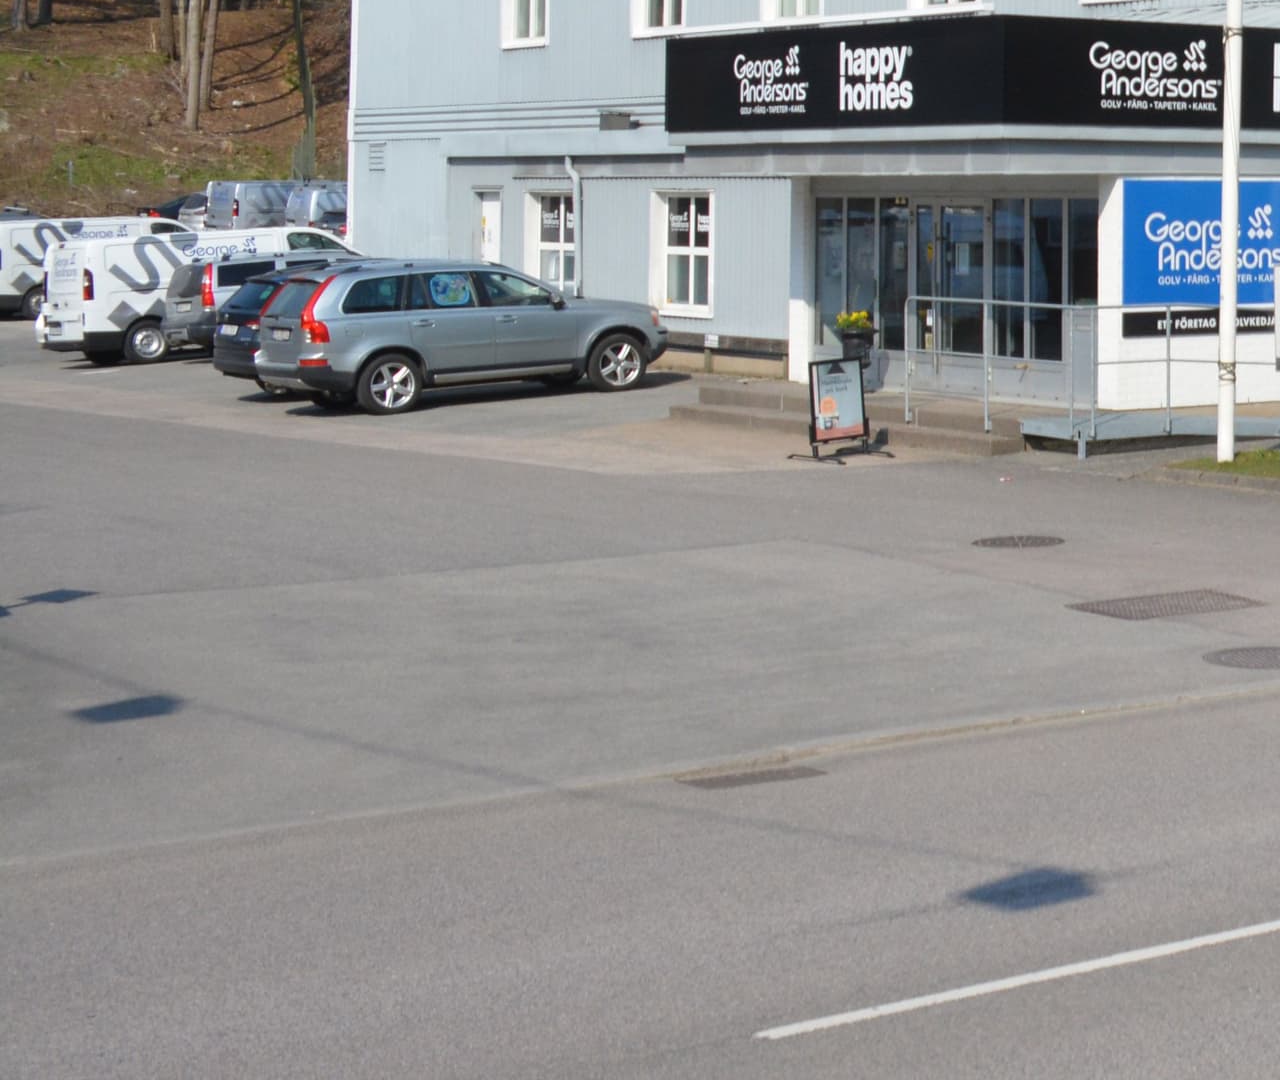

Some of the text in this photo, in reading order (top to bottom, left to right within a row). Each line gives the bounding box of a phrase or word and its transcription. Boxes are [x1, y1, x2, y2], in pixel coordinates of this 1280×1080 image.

[733, 54, 783, 83] George
[839, 41, 907, 82] happy
[1089, 40, 1178, 78] George
[740, 80, 807, 102] Andersons
[839, 77, 913, 111] homes
[1101, 68, 1218, 97] Andersons
[1100, 99, 1122, 109] GOLV
[1153, 100, 1188, 110] TAPETER
[1192, 102, 1218, 112] KAKEL
[1158, 275, 1182, 286] GOLV
[1175, 316, 1217, 330] FÖRETAG
